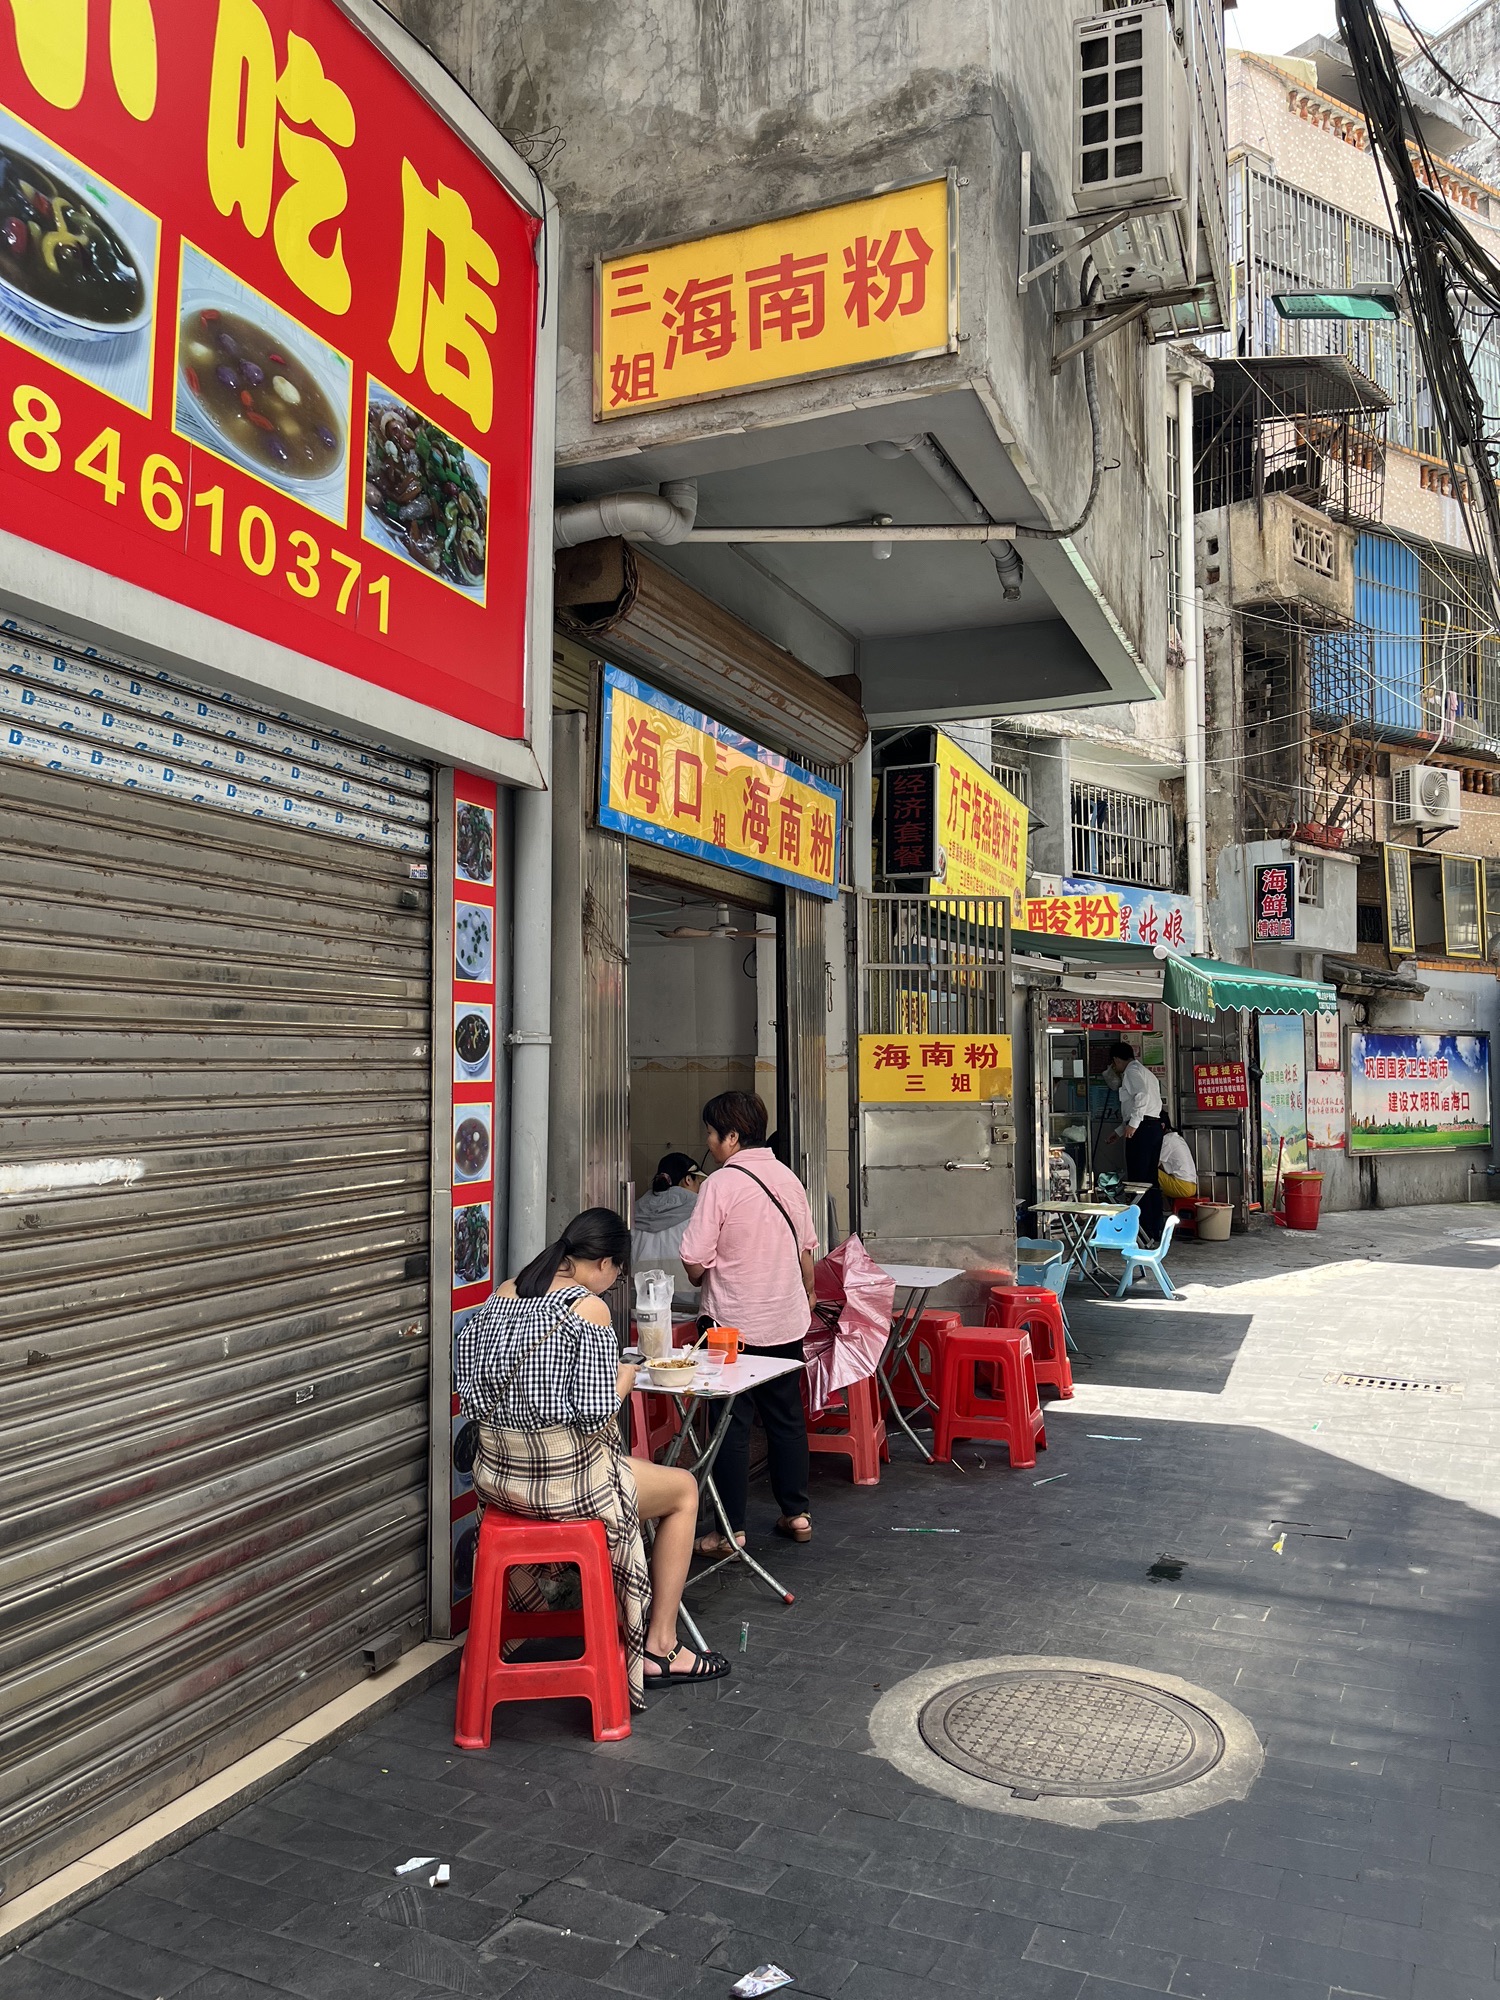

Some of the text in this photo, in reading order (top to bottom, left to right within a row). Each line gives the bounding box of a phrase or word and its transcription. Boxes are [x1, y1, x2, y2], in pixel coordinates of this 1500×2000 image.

[660, 227, 934, 371] 海南粉
[8, 384, 391, 635] 84610371
[622, 716, 703, 824] 海口
[740, 774, 834, 878] 海南粉
[892, 773, 928, 869] 经济套餐
[1261, 869, 1288, 918] 海鲜
[1027, 896, 1119, 938] 酸粉
[872, 1041, 999, 1070] 海南粉
[1198, 1065, 1242, 1077] 温馨提示
[1364, 1056, 1449, 1081] 巩固国家卫生城市
[904, 1072, 972, 1093] 三姐
